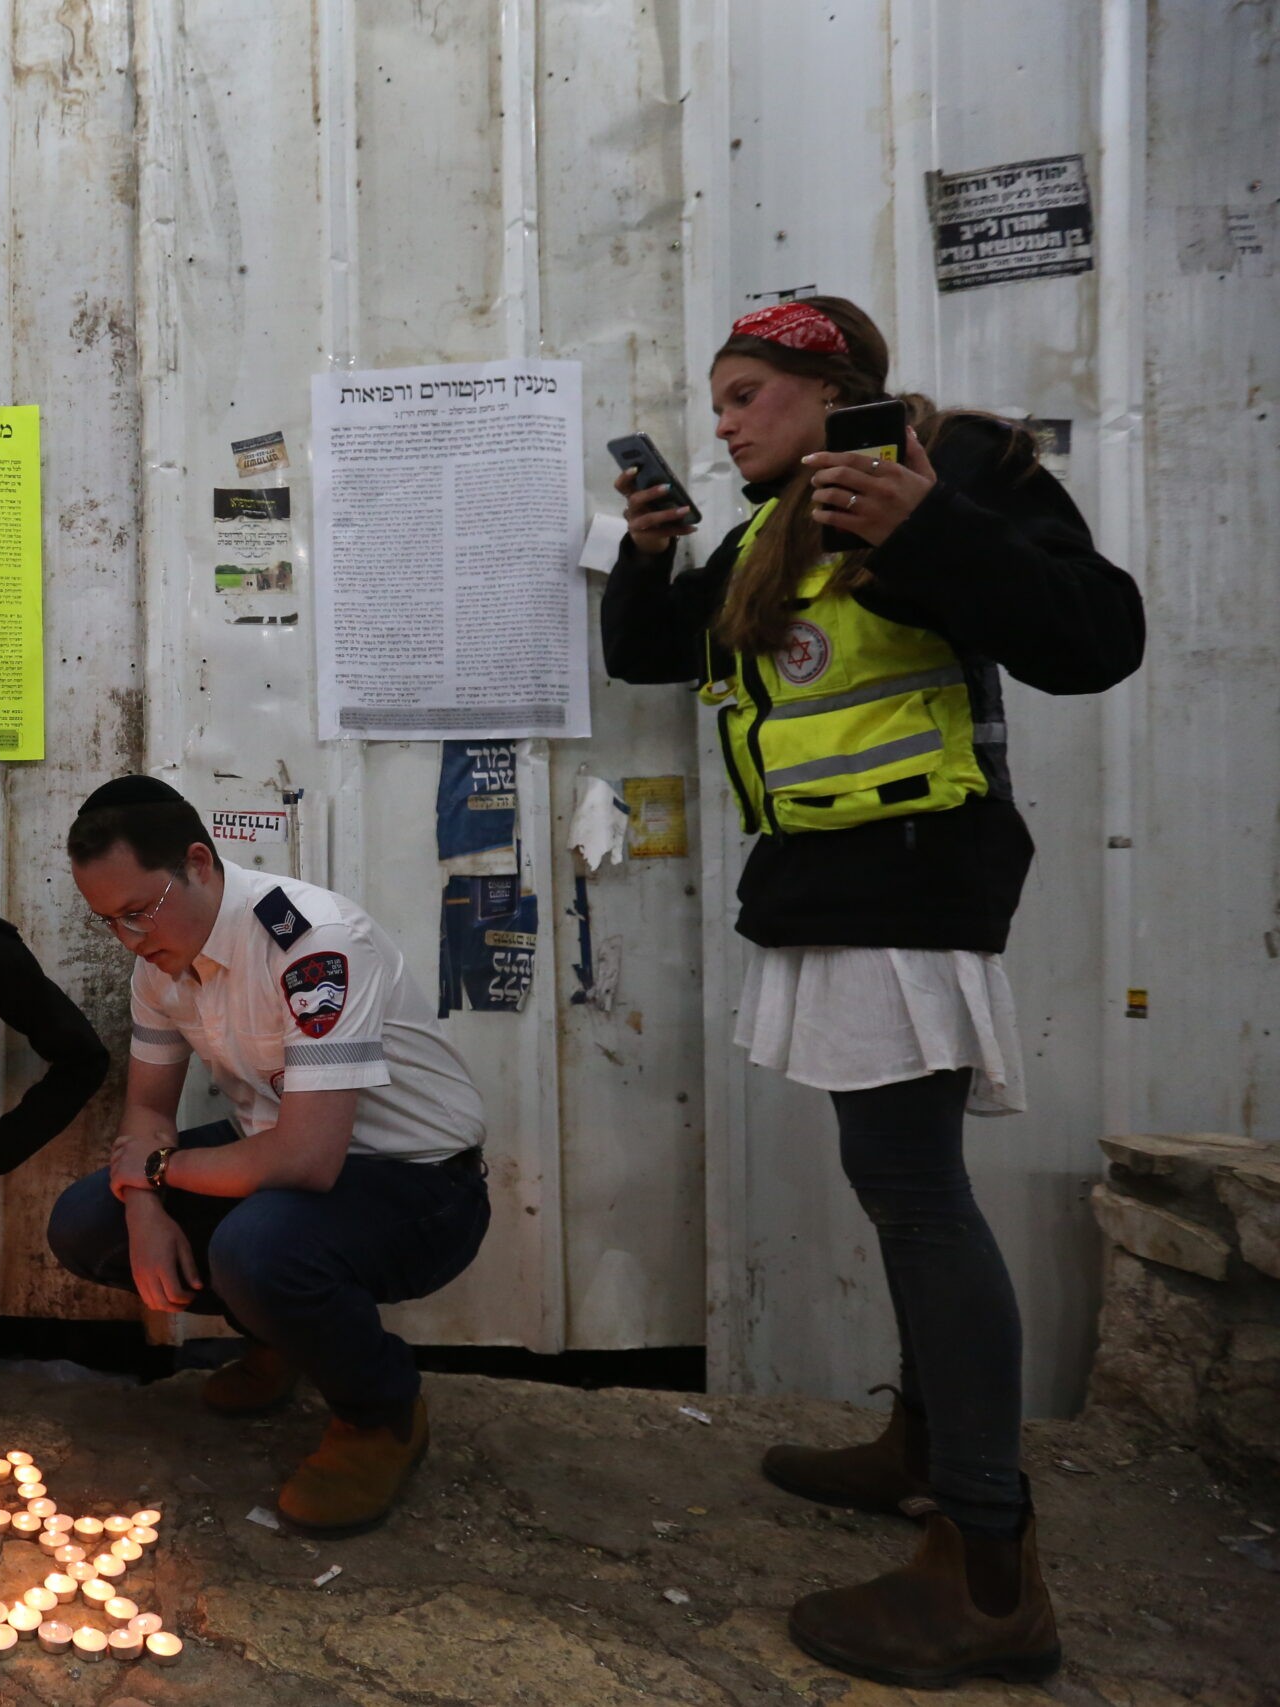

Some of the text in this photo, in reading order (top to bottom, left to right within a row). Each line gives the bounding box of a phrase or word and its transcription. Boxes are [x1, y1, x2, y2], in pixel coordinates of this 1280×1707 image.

[991, 172, 1022, 189] יקר
[1028, 166, 1067, 181] יהודי
[1002, 213, 1049, 238] אהרן
[1064, 228, 1085, 248] בן
[341, 375, 557, 403] מענין דוקטורים ורפואות
[213, 813, 279, 831] תתבודד!
[213, 826, 256, 842] בודד?
